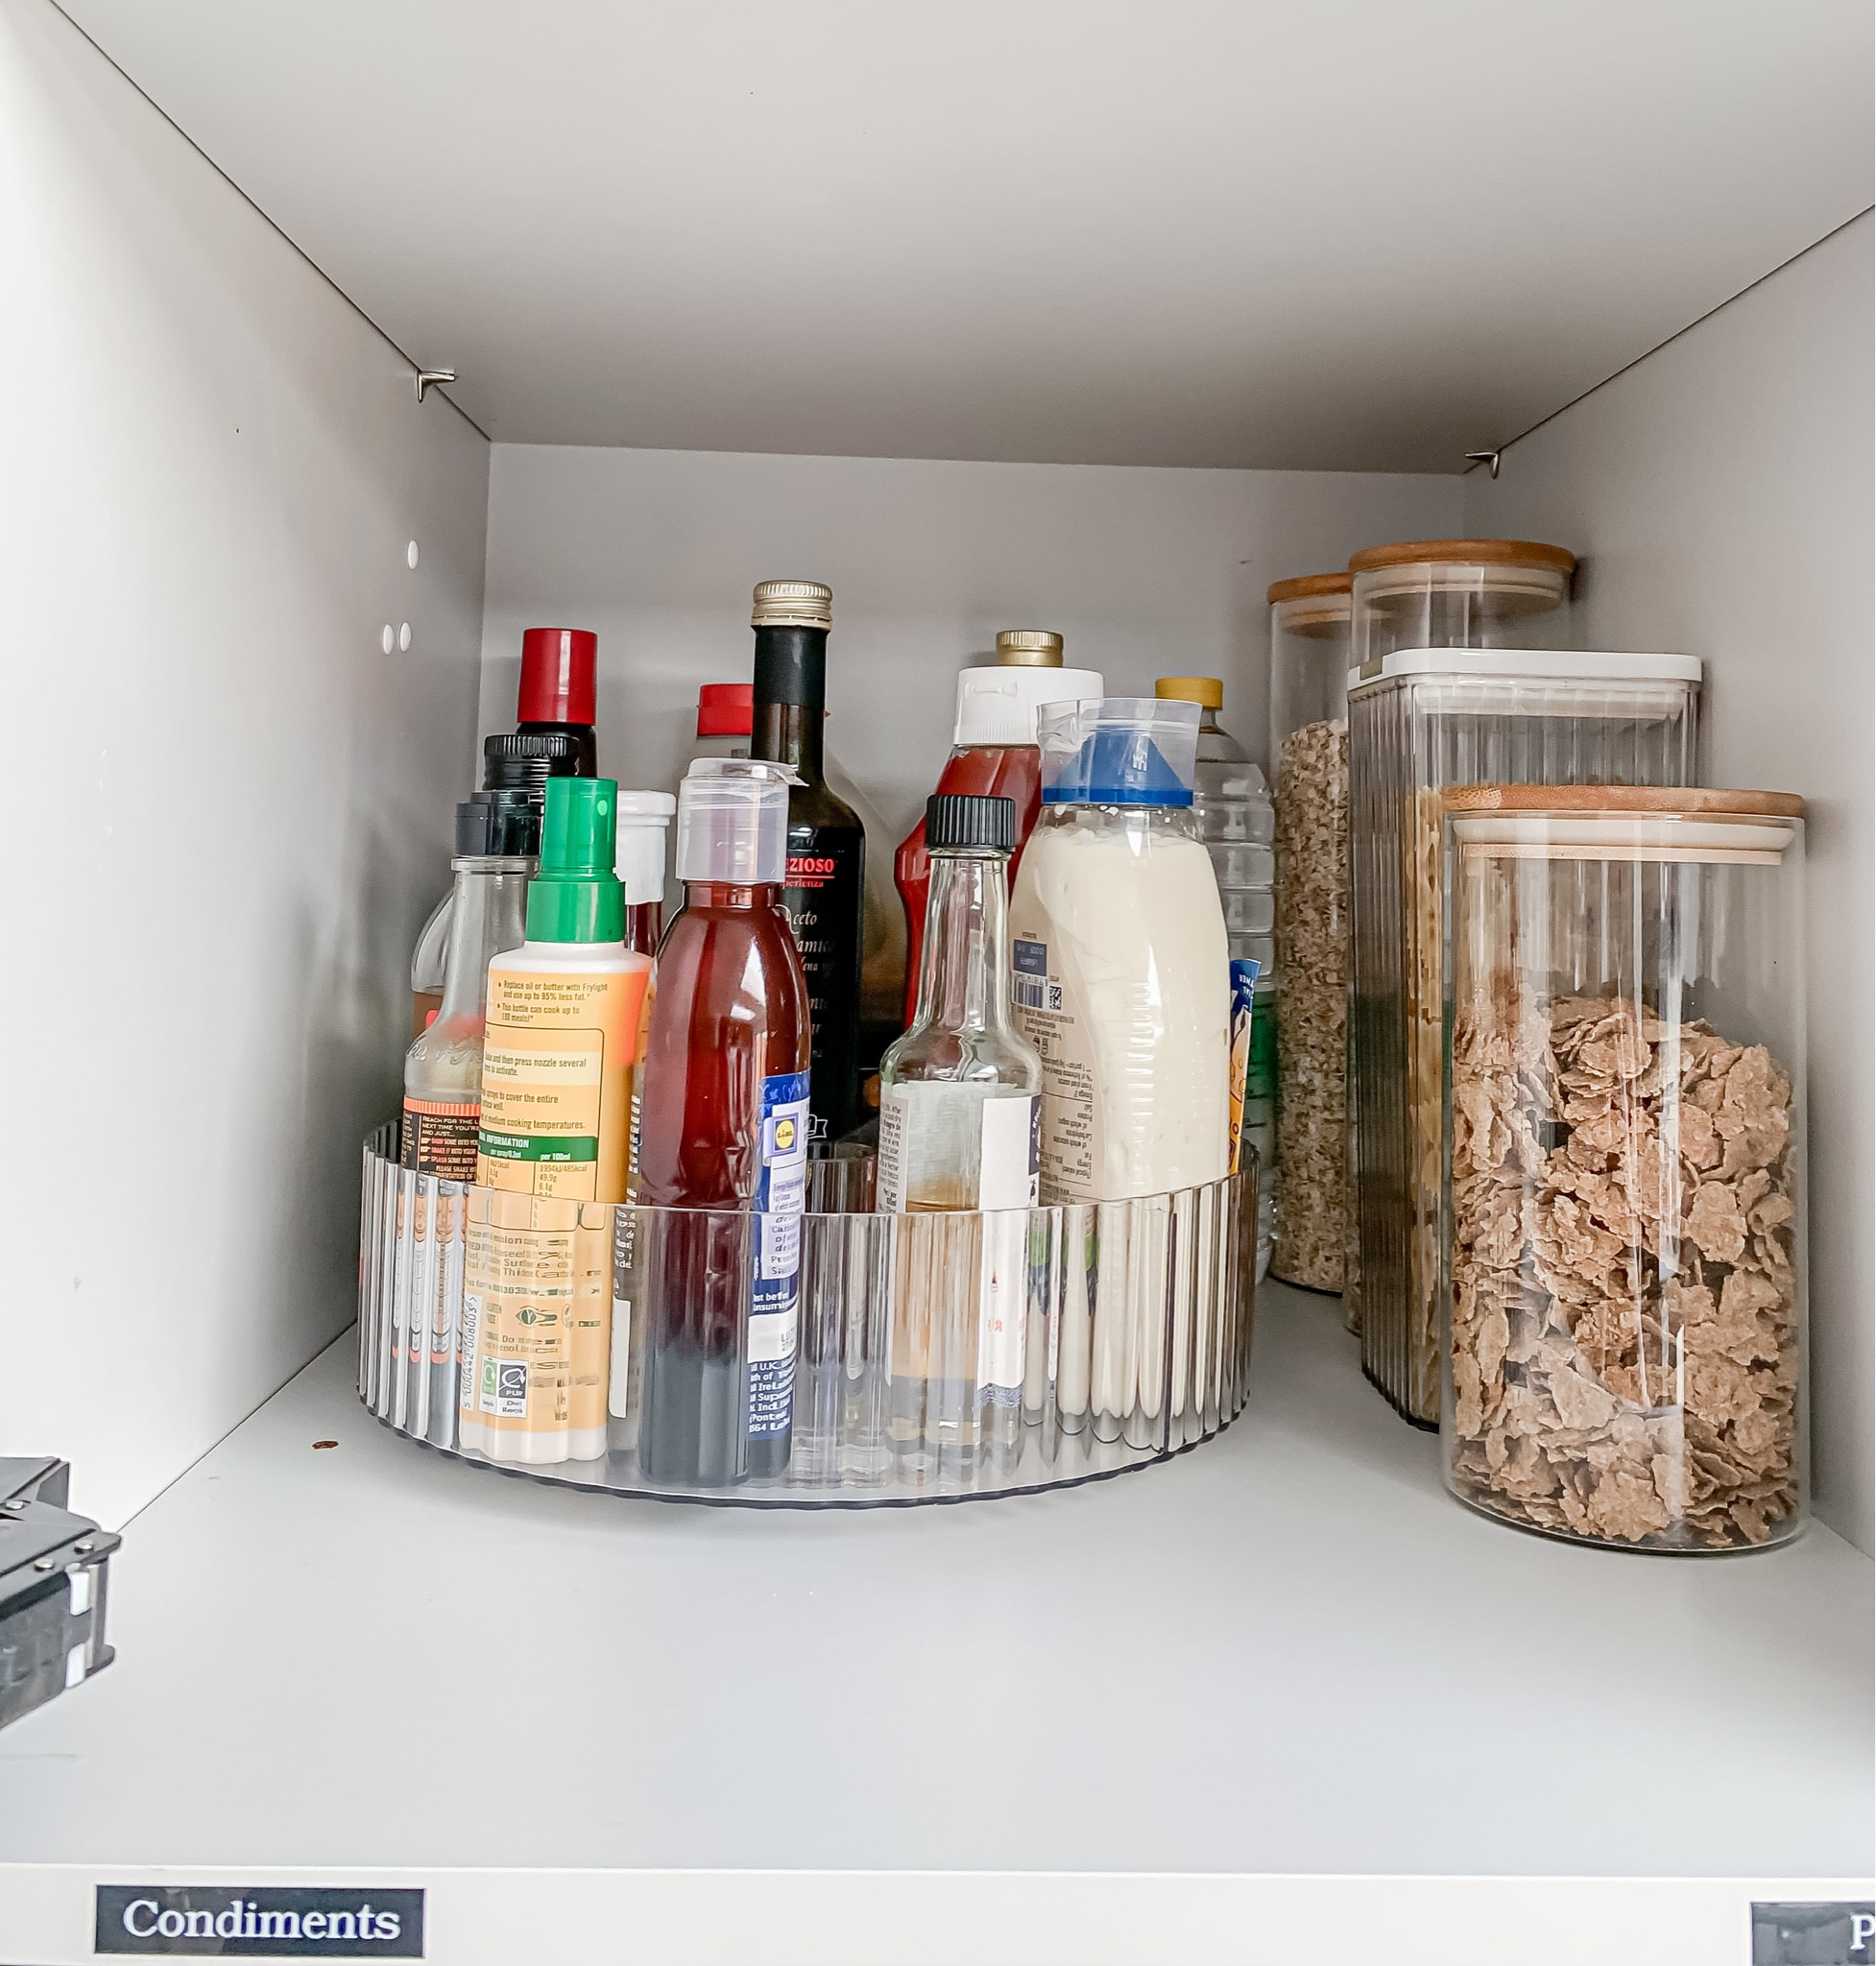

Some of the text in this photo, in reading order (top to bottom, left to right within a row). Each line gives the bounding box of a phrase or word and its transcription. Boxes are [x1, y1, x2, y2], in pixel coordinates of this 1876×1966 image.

[503, 979, 524, 990] Replace
[525, 981, 534, 990] oil
[543, 981, 565, 991] butter
[582, 983, 608, 993] Frylight
[502, 1002, 512, 1011] This
[513, 1004, 528, 1013] bottle
[502, 1056, 513, 1065] then
[515, 1058, 532, 1067] press
[534, 1058, 557, 1067] nozzle
[559, 1058, 587, 1067] several
[495, 1067, 518, 1076] activate.
[537, 1094, 559, 1104] entire
[507, 1119, 532, 1130] cooking
[534, 1120, 586, 1131] temperatures.
[486, 1135, 529, 1148] INFORMATION
[552, 1152, 571, 1161] 100ml
[540, 1163, 588, 1173] 1994kJ/485kcal
[540, 1173, 557, 1183] 49.9g
[539, 1183, 553, 1191] 6.1g
[123, 1899, 401, 1940] Condiments
